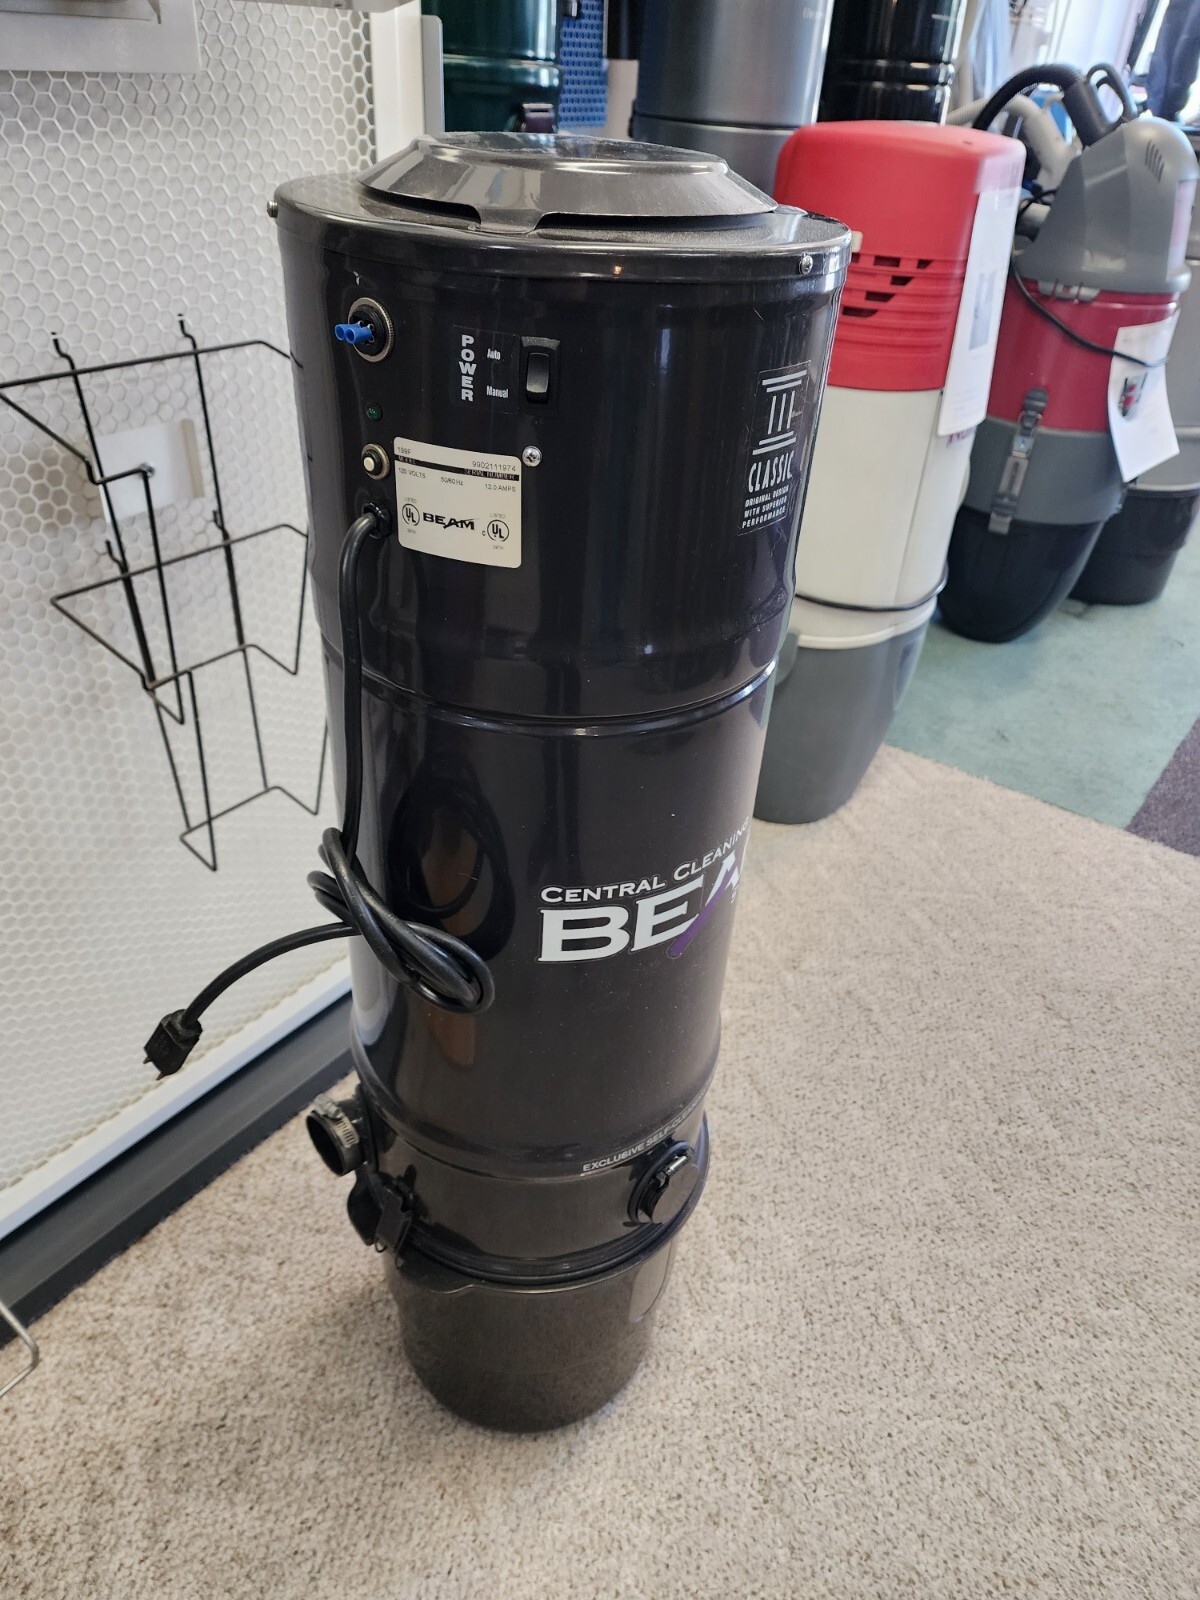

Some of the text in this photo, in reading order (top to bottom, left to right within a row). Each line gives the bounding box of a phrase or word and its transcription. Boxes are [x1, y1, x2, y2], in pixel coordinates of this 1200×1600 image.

[487, 348, 501, 360] Auto
[459, 334, 476, 402] POWER
[486, 385, 509, 398] Manual
[409, 469, 426, 479] VOLTS
[748, 450, 794, 493] CLASSIC
[497, 485, 516, 493] AMPS
[745, 492, 771, 508] ORIGINAL
[423, 512, 475, 530] BEAM
[742, 505, 786, 529] PERFORMANCE
[744, 506, 760, 518] WITH
[541, 816, 750, 903] CENTRAL CLEANING
[538, 850, 741, 963] BEA
[583, 1144, 645, 1172] EXCLUSIVE
